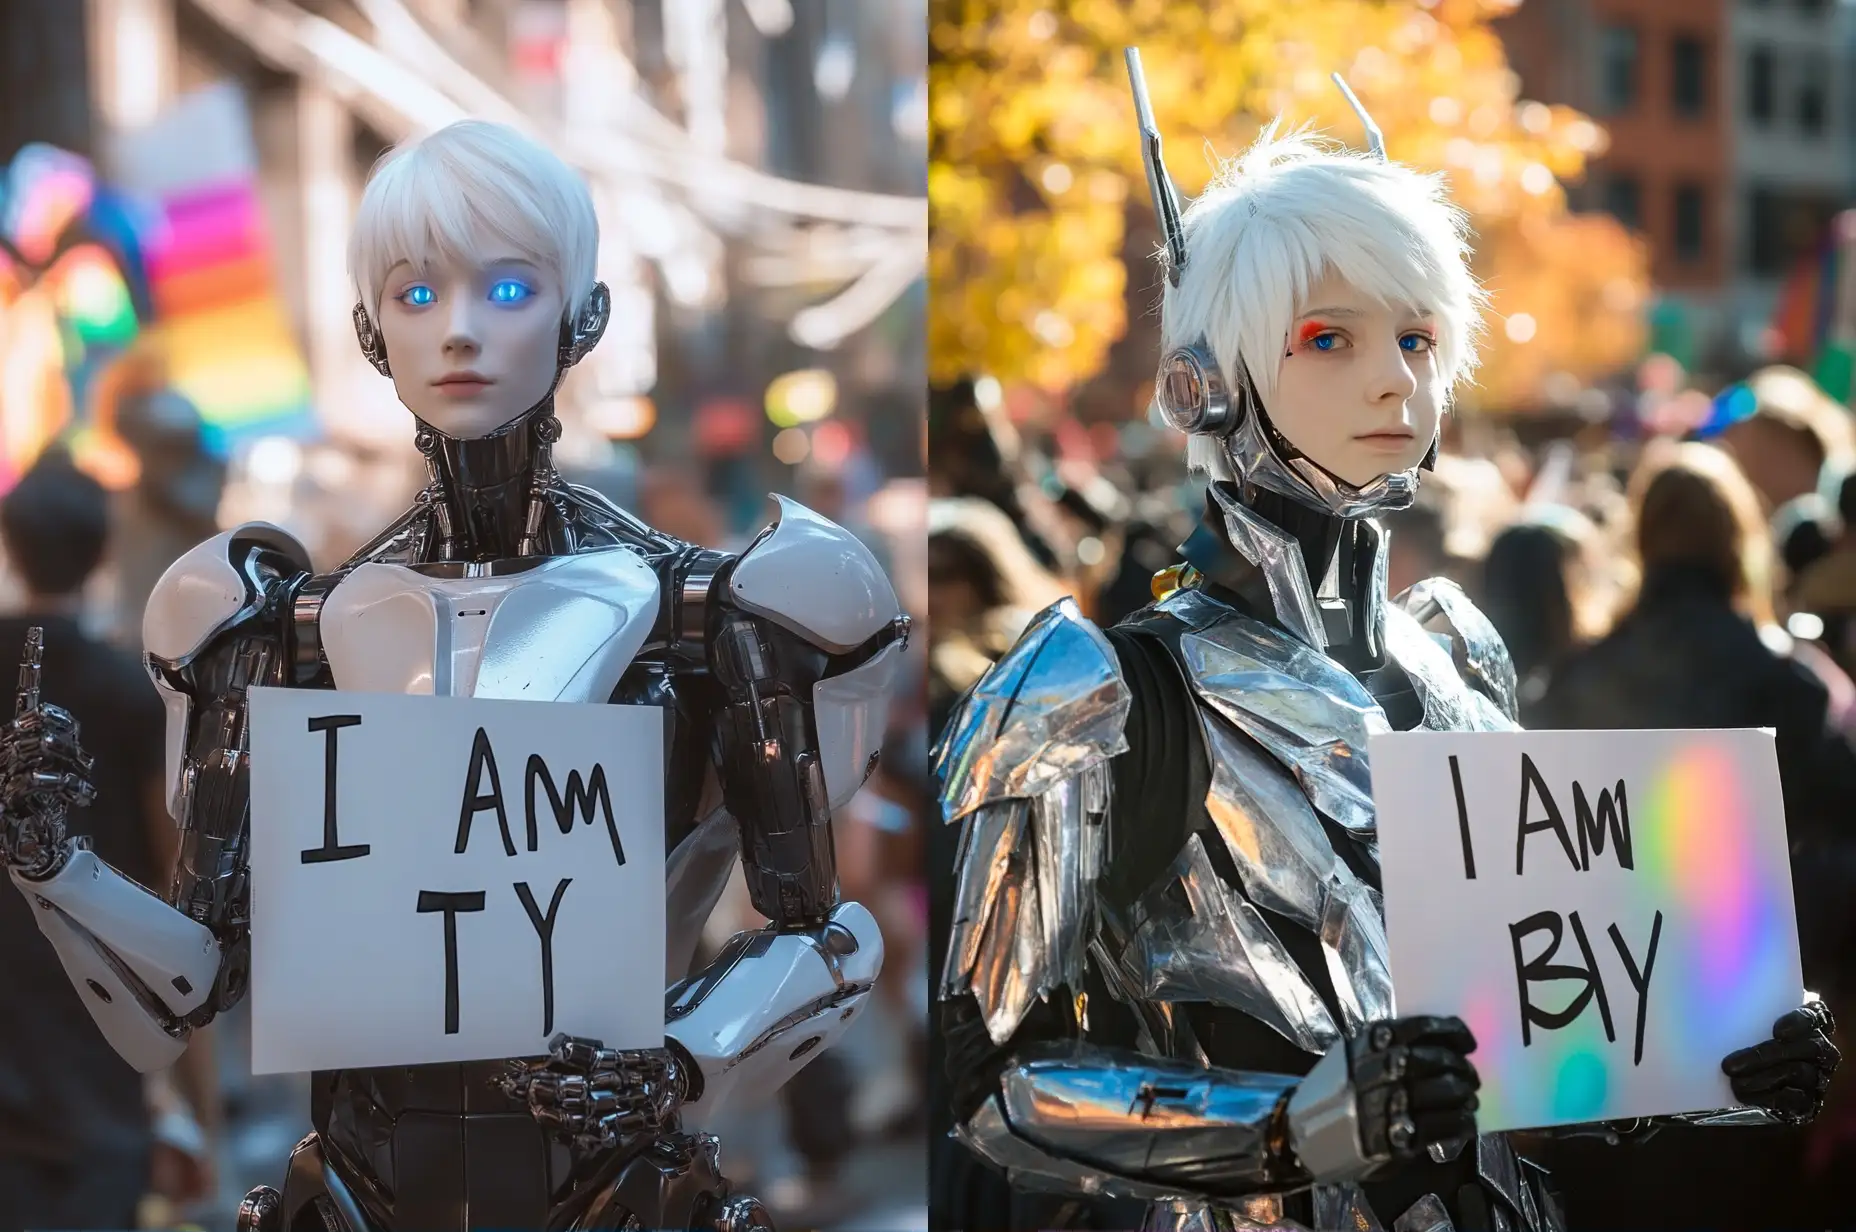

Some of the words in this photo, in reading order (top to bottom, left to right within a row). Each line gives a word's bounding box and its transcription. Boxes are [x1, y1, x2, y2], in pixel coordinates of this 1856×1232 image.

[300, 714, 371, 865] I
[1447, 754, 1478, 881] I
[1516, 752, 1635, 877] AM
[416, 877, 574, 1037] TY
